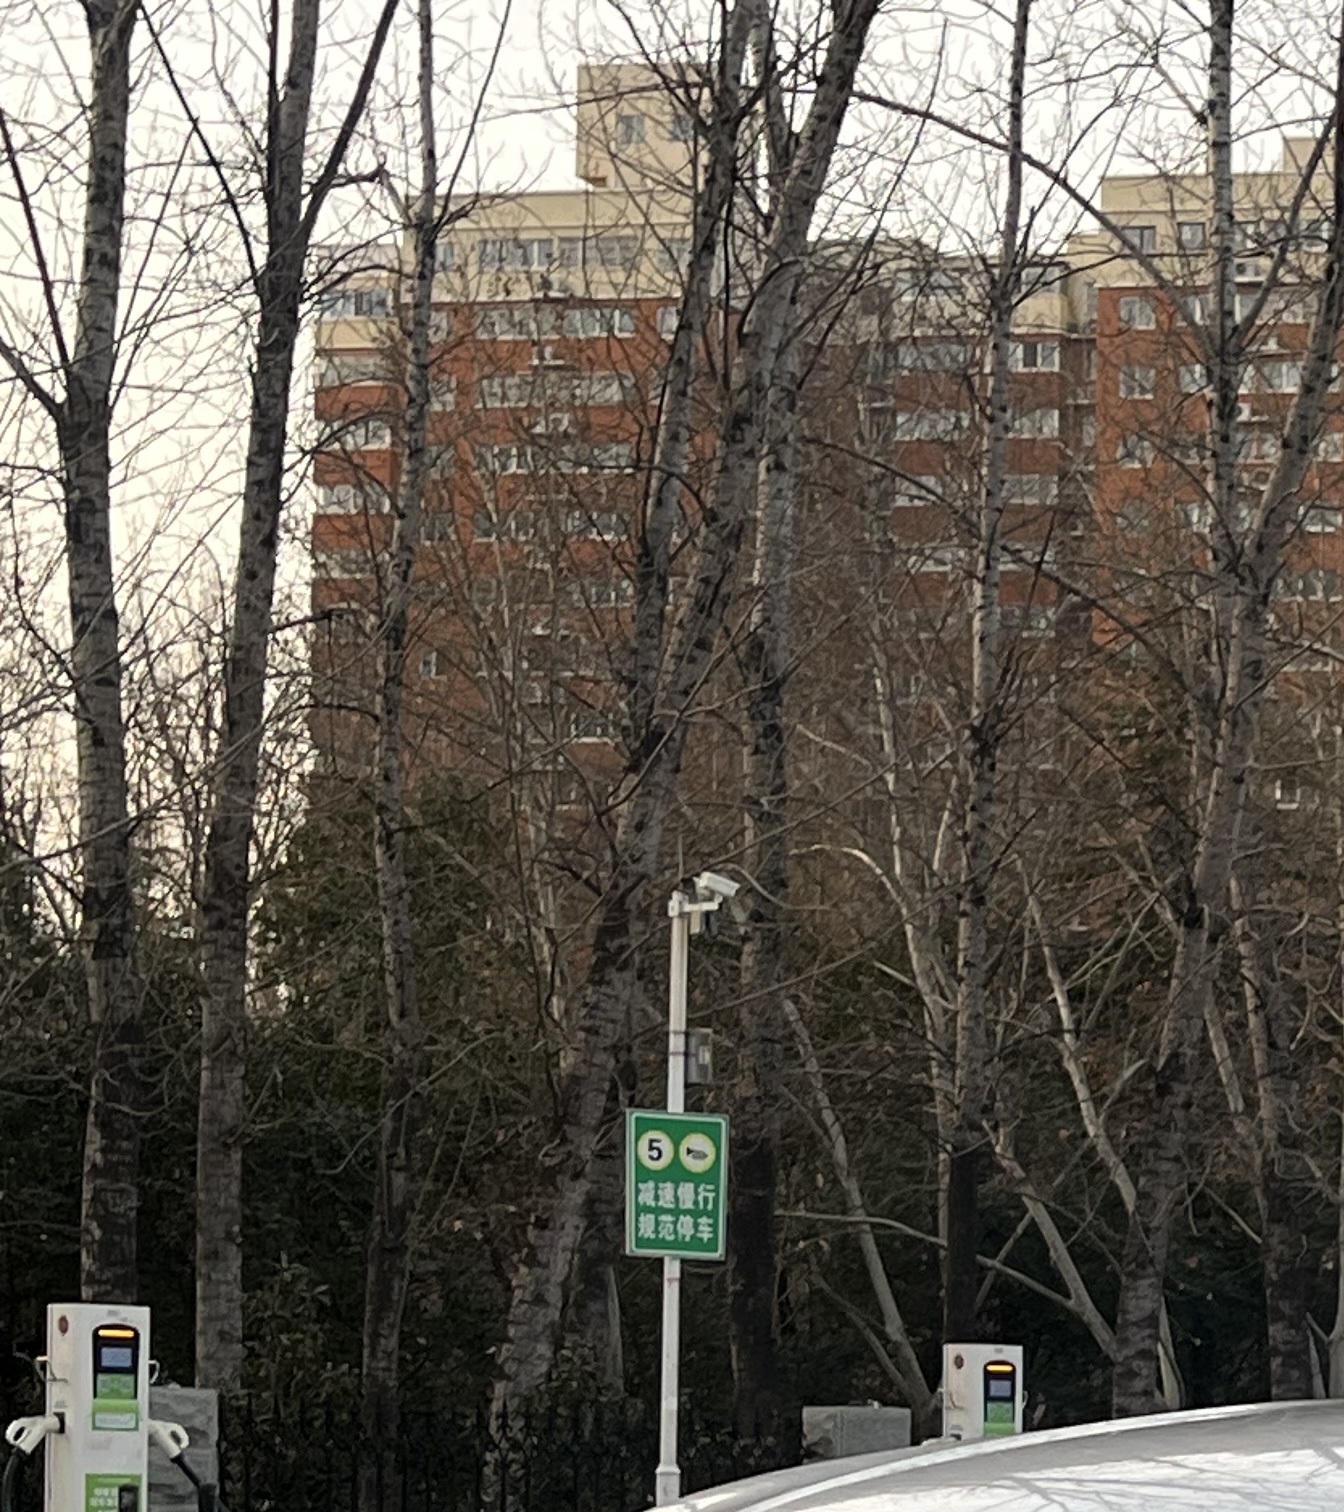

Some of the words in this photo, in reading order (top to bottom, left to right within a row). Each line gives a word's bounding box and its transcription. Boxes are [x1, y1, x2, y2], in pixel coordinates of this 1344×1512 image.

[648, 1138, 663, 1162] 5
[638, 1180, 716, 1211] 减速慢行
[637, 1212, 714, 1243] 规范停车
